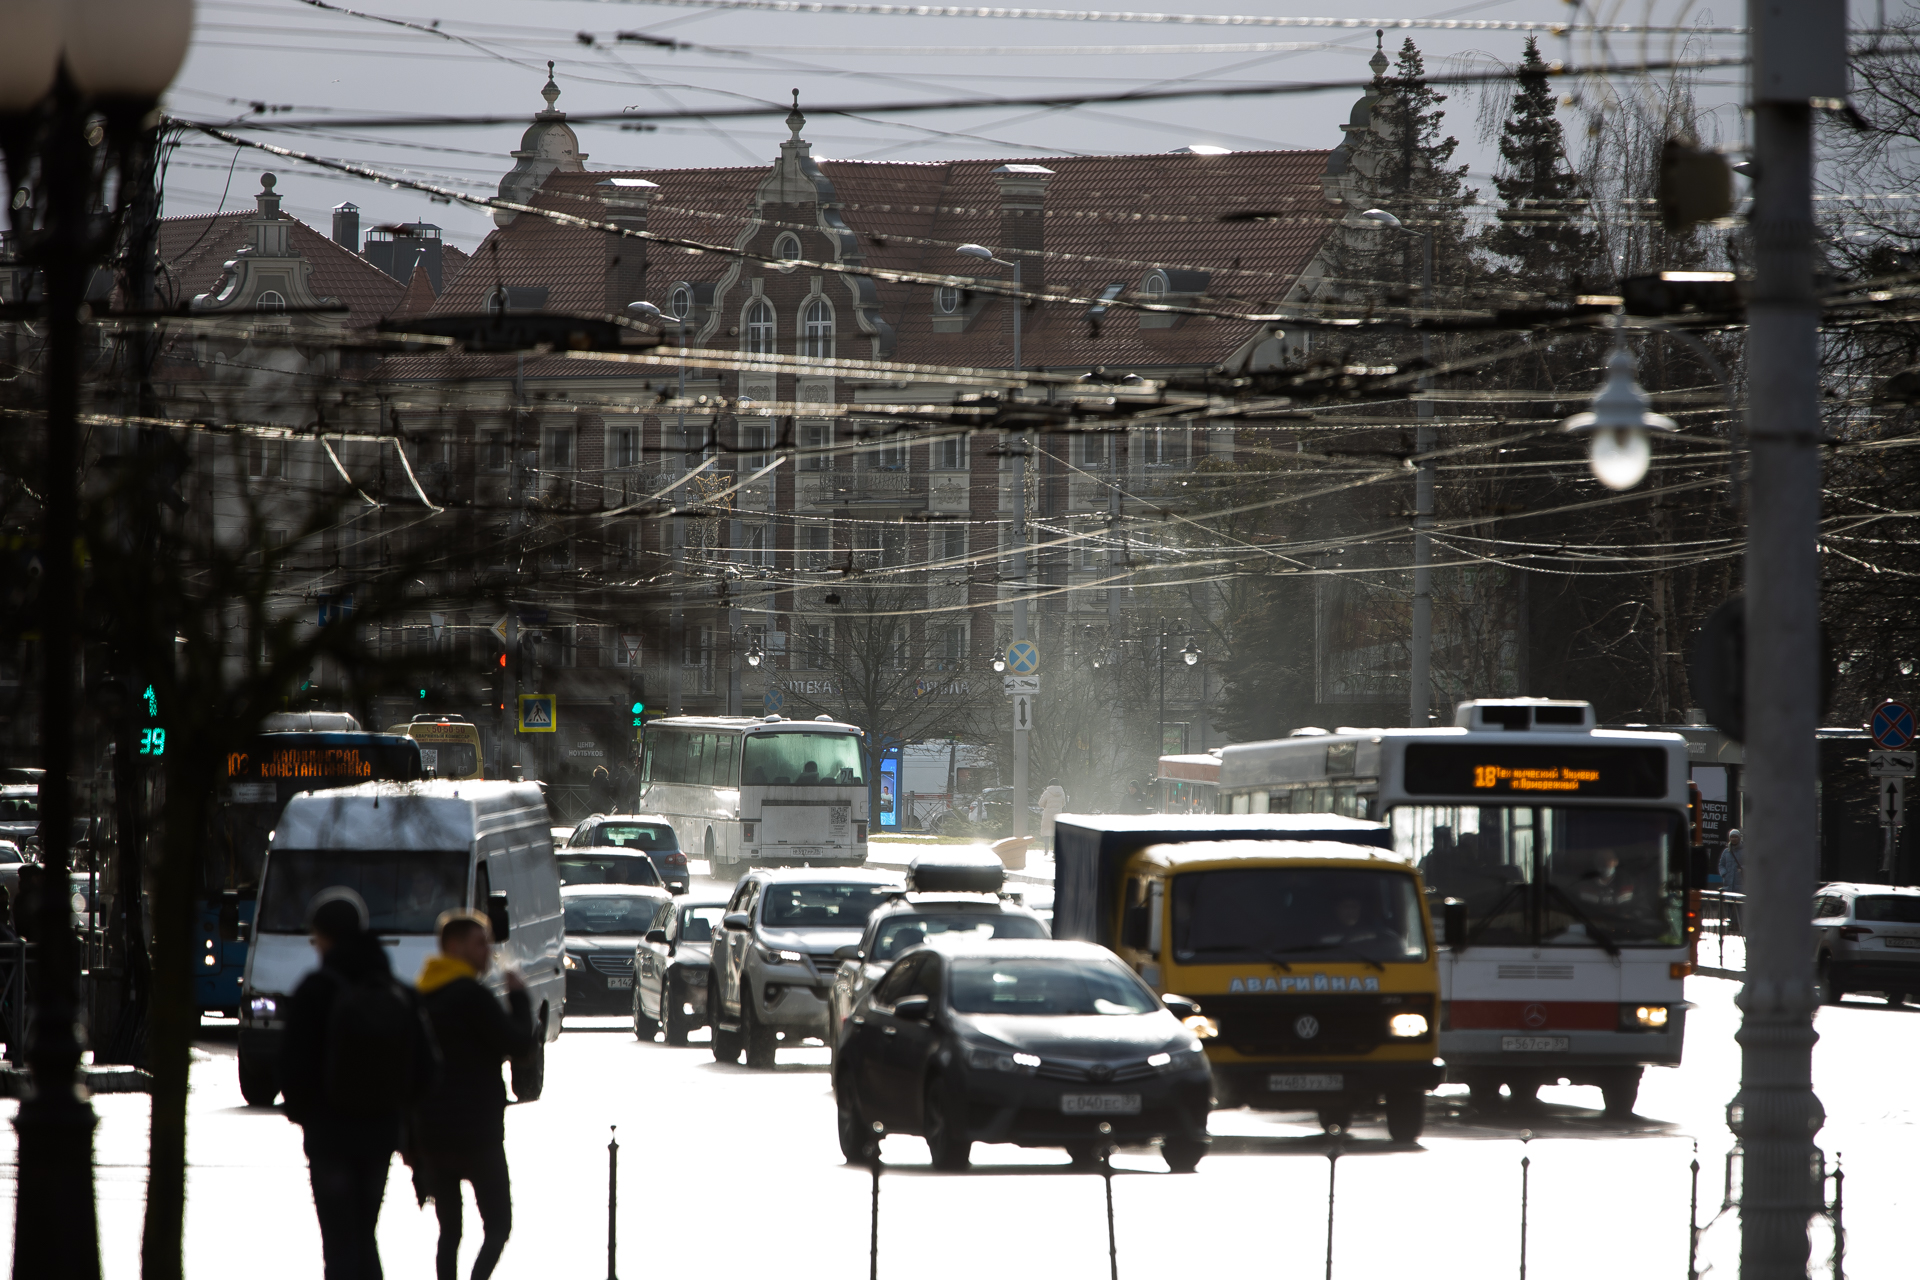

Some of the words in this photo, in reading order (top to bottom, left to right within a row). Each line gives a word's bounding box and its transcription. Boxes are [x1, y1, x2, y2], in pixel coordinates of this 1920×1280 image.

[140, 728, 165, 755] 39
[577, 741, 595, 749] ЦЕНТР
[272, 749, 360, 764] КАЛИНИНГРАД
[261, 761, 371, 777] КОНСТАНТИНОВКА
[841, 770, 853, 784] 24
[1474, 766, 1496, 787] 18
[1229, 973, 1380, 993] АВАРИЙНАЯ
